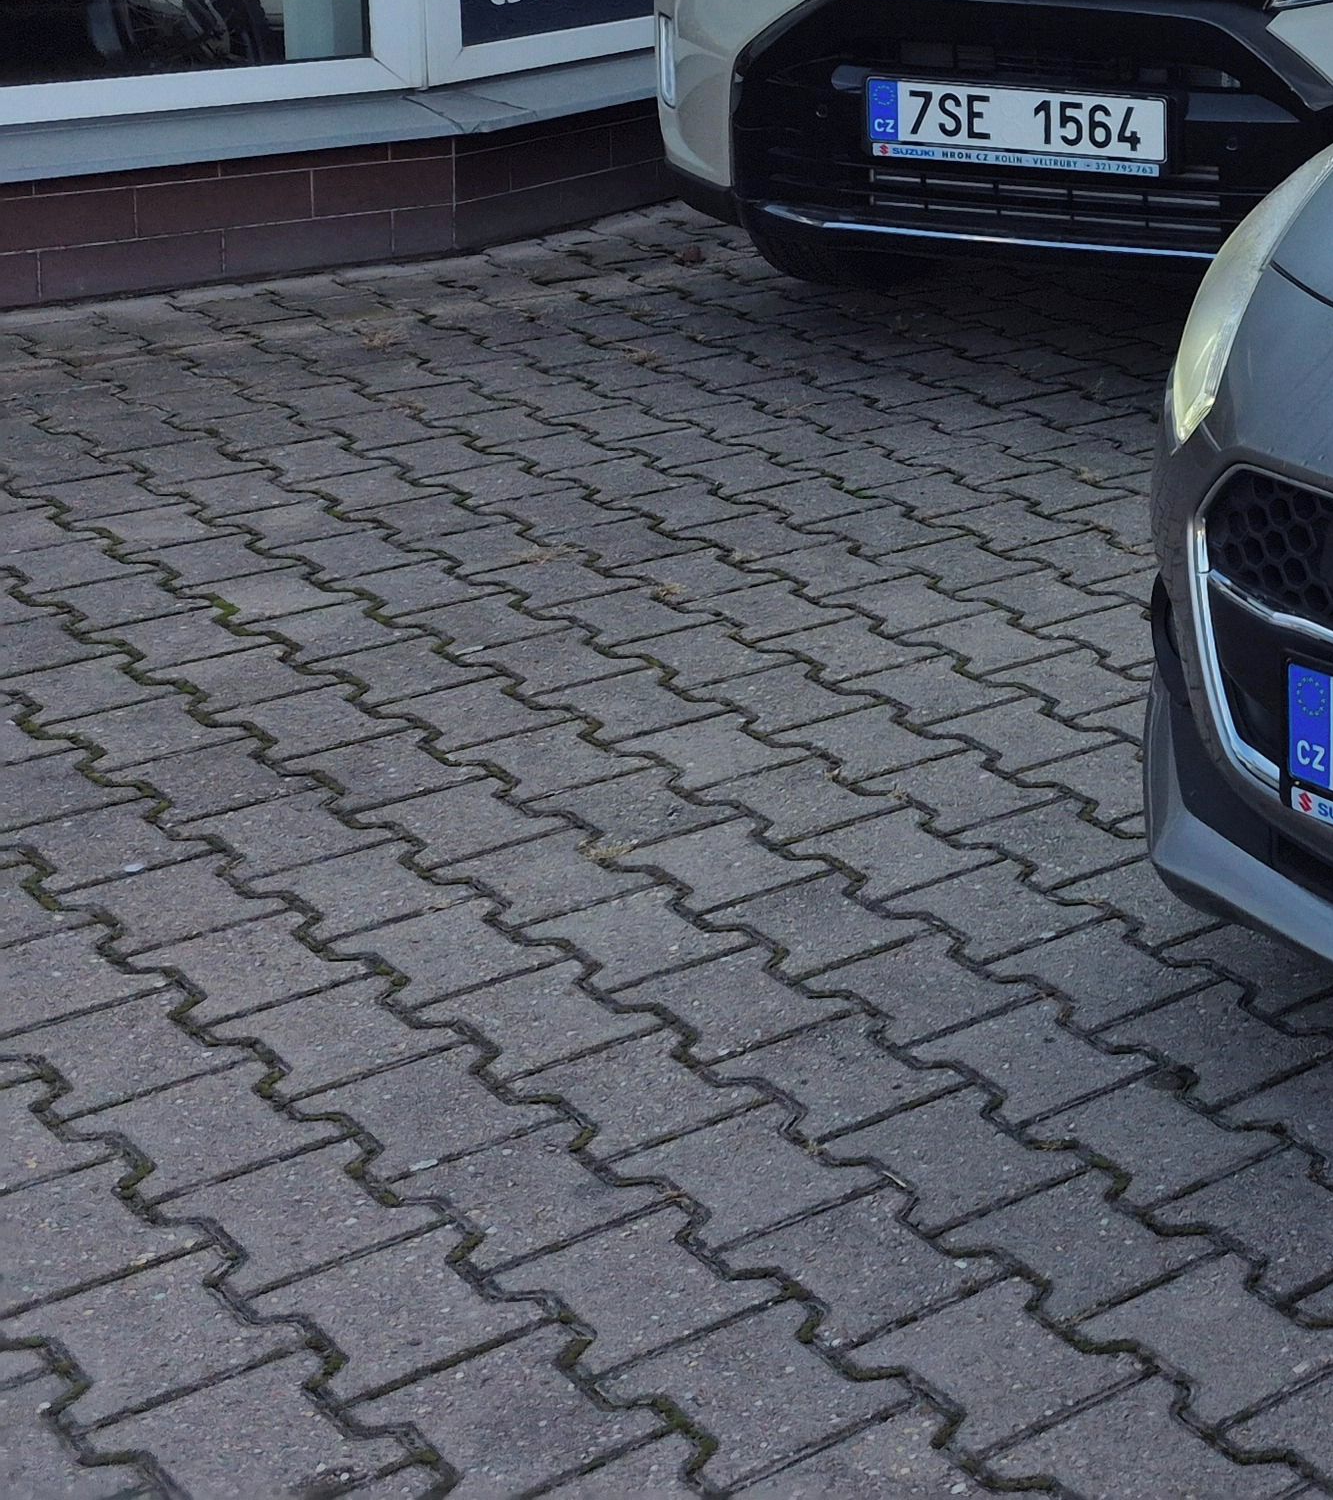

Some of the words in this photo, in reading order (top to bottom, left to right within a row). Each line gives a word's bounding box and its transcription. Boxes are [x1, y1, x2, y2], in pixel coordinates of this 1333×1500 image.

[874, 119, 895, 133] CZ
[909, 90, 991, 140] 7SE
[1034, 100, 1141, 152] 1564
[892, 147, 935, 157] SUZUKI
[942, 151, 972, 160] HRON
[1033, 158, 1078, 168] VELTRUBY
[1095, 163, 1111, 171] 321
[1115, 164, 1132, 173] 795
[1136, 166, 1153, 174] 763
[1296, 739, 1326, 772] CZ
